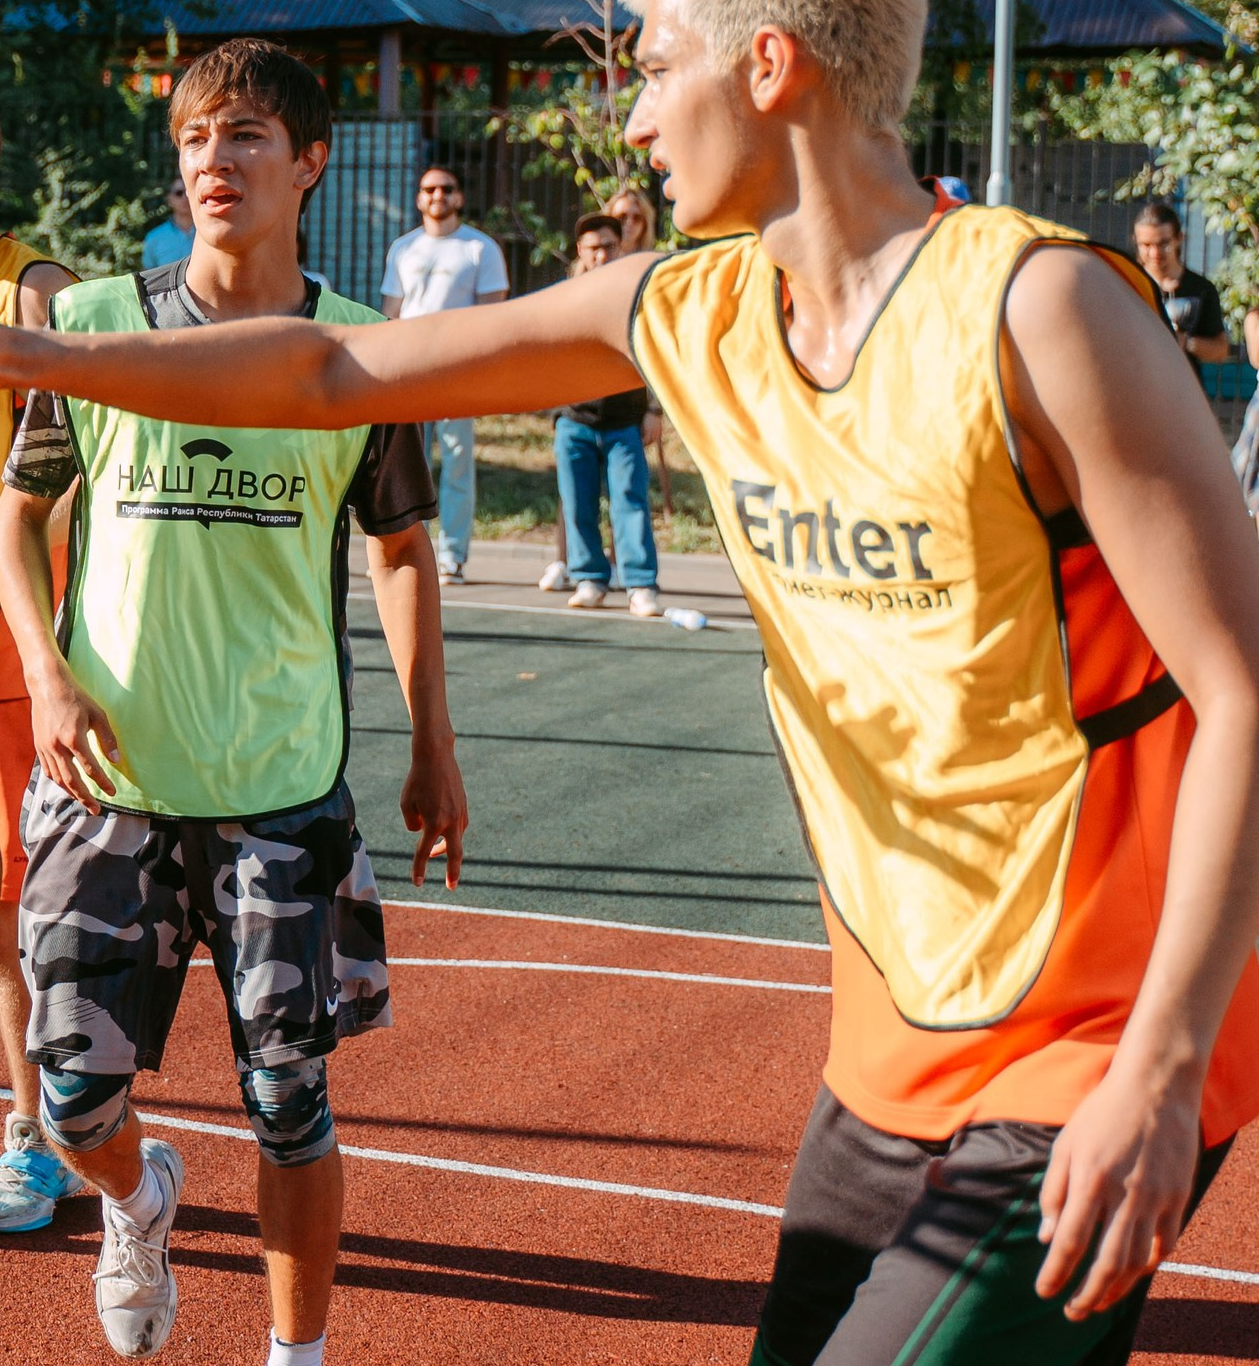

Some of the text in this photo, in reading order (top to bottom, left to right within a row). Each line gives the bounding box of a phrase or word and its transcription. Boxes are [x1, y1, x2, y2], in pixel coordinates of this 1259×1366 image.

[118, 464, 306, 502] НАШ ДВОР
[121, 504, 297, 524] Программа Раиса Республики Татарстан
[730, 479, 934, 581] Enter
